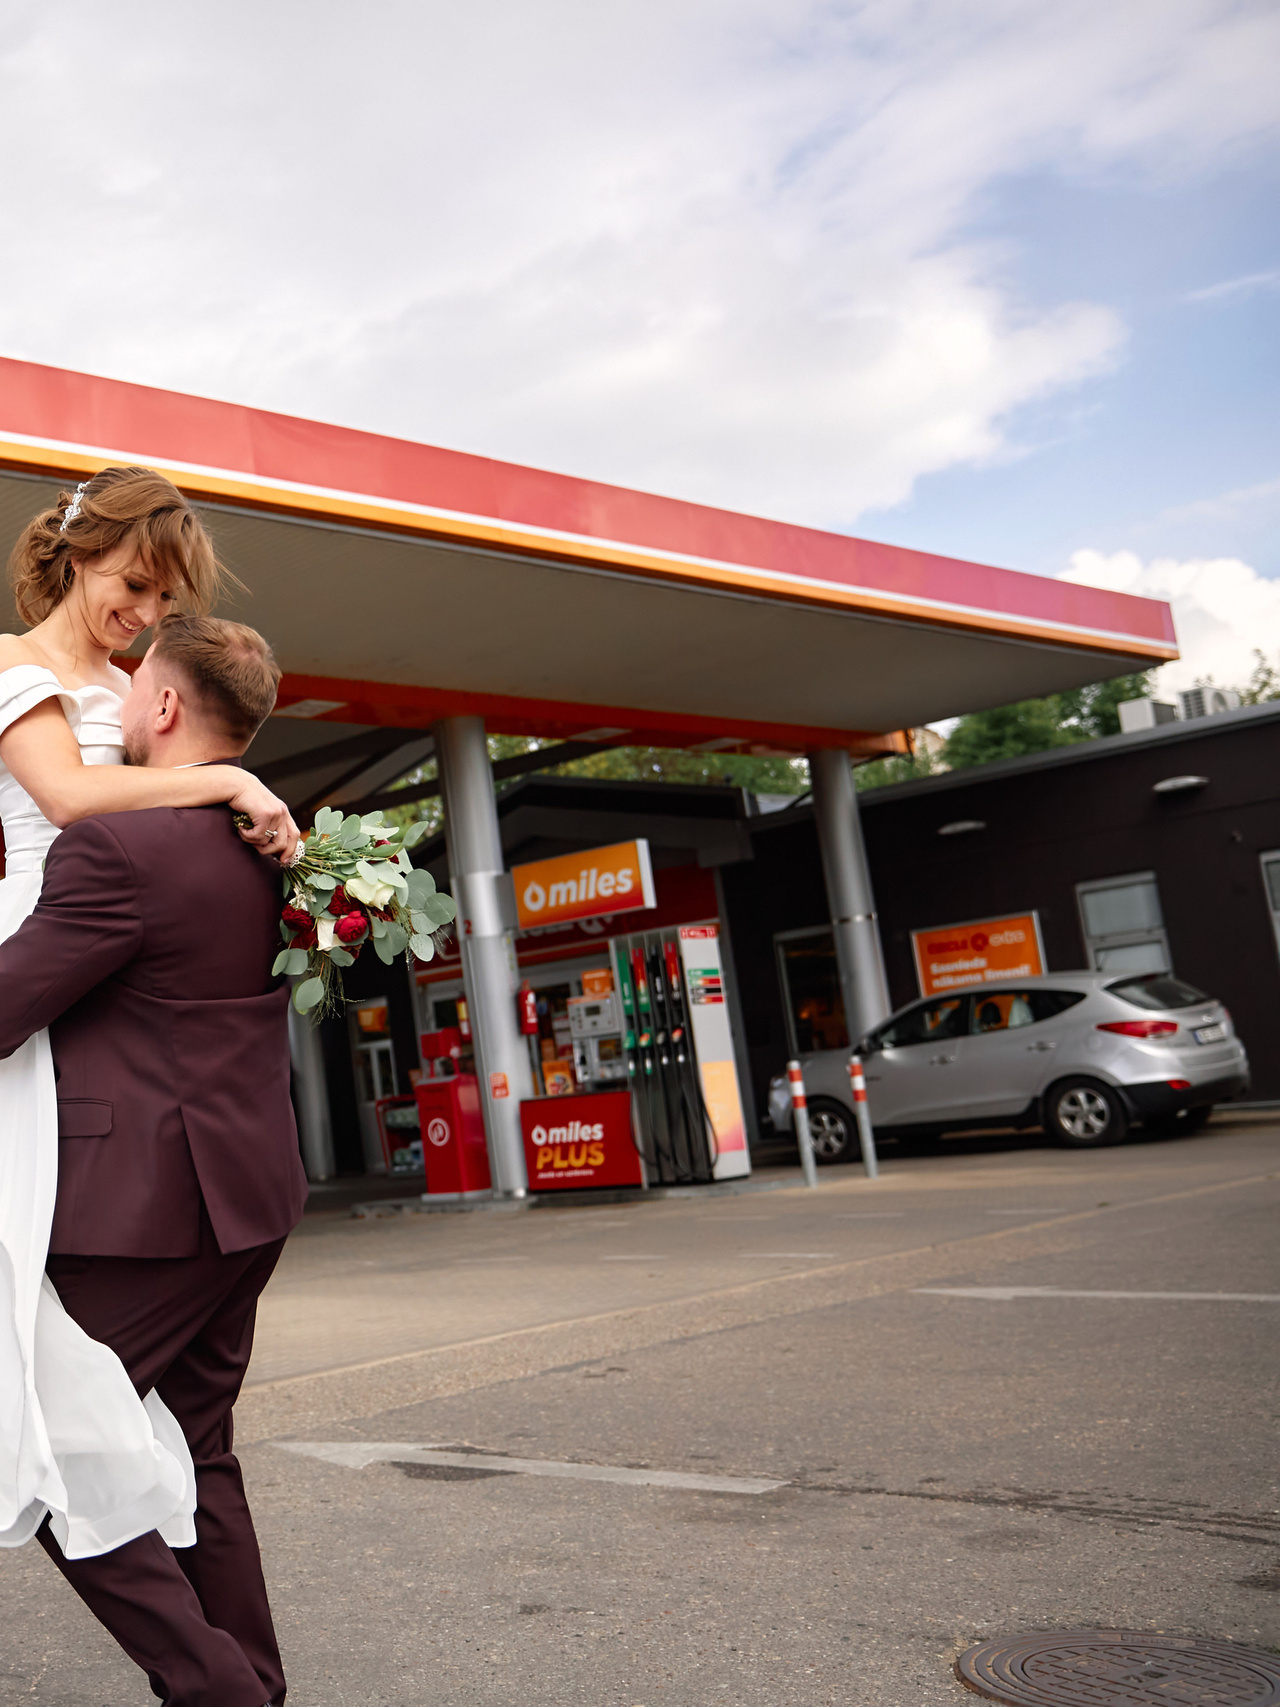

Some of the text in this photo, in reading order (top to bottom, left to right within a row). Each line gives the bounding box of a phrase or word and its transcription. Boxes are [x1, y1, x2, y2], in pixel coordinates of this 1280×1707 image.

[549, 867, 633, 908] miles
[547, 1120, 604, 1144] miles
[535, 1141, 605, 1170] PLUS
